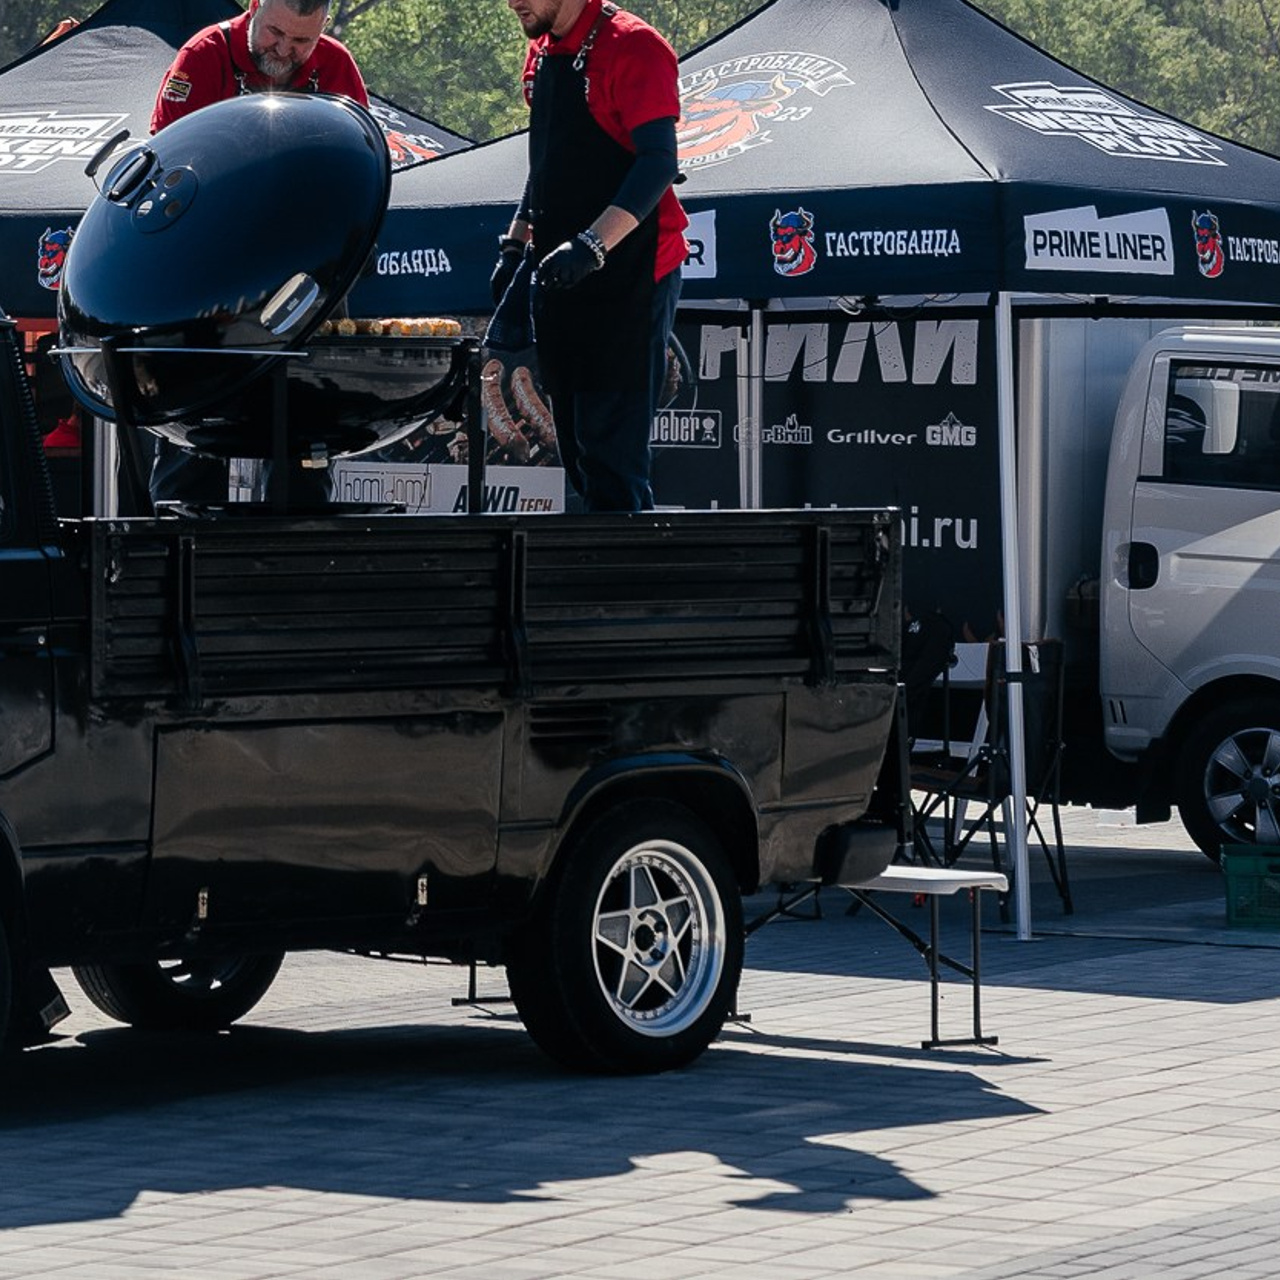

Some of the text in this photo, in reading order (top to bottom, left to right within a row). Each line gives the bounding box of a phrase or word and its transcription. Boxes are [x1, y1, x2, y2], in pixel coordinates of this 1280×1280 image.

[772, 106, 813, 122] 23
[26, 125, 90, 136] LINER
[826, 230, 961, 257] ГАСТРОБАНДА
[1033, 230, 1167, 261] PRIME LINER
[1228, 236, 1280, 264] ГАСТРОБ
[827, 428, 918, 445] Grillver
[925, 425, 977, 447] GMG
